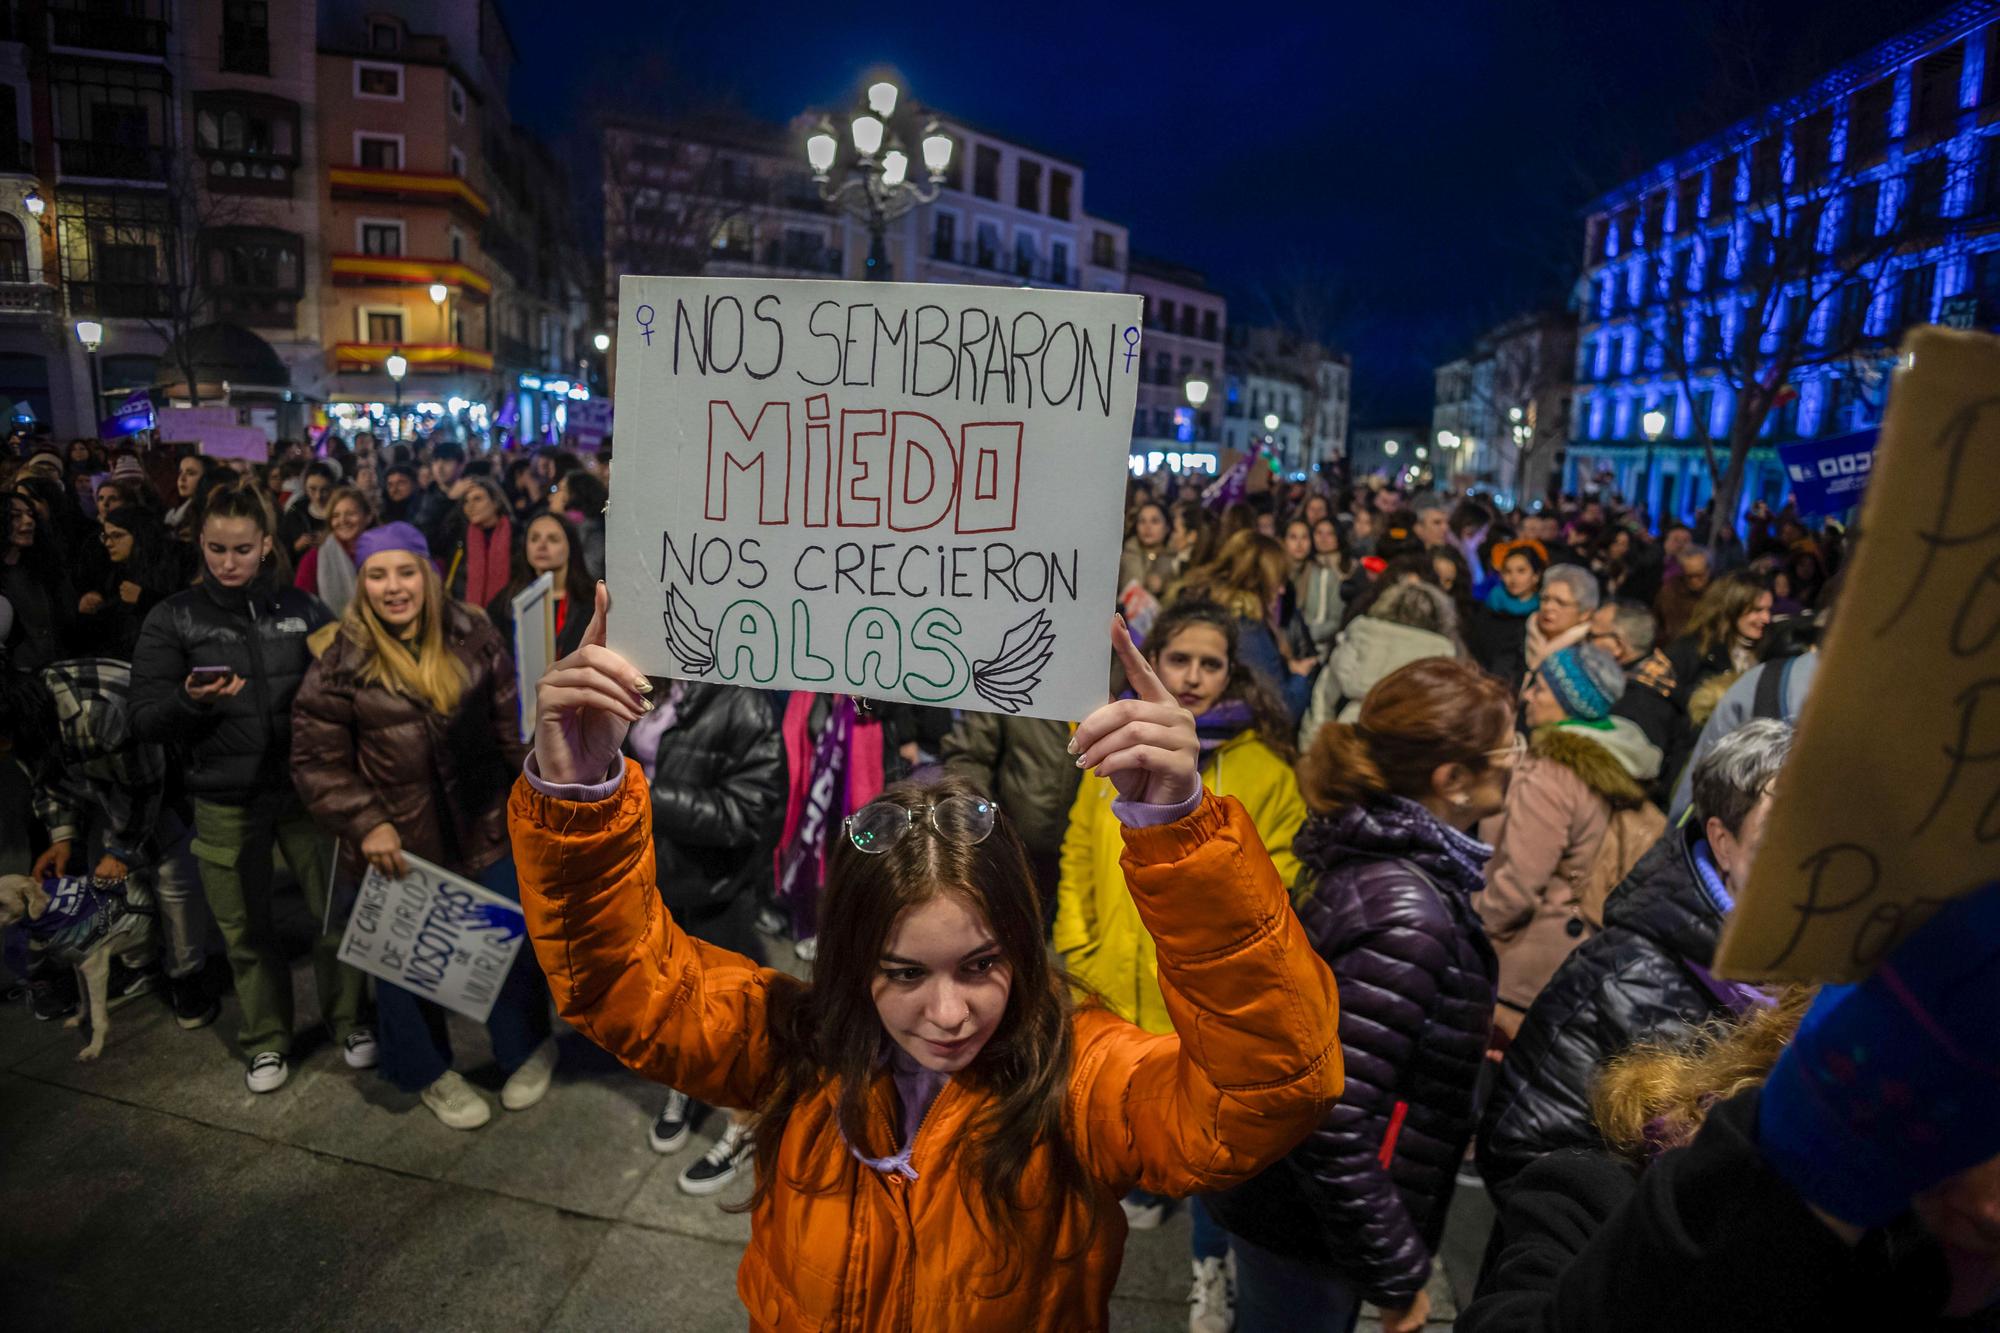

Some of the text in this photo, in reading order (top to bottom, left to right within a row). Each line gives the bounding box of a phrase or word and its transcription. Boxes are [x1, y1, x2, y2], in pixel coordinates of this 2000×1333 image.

[673, 294, 1116, 417] NOS SEMBRARON
[660, 531, 768, 588] NOS
[715, 598, 971, 702] ALAS
[345, 933, 373, 959] TE
[380, 941, 407, 971] DE
[403, 881, 474, 993] NOSOTRAS
